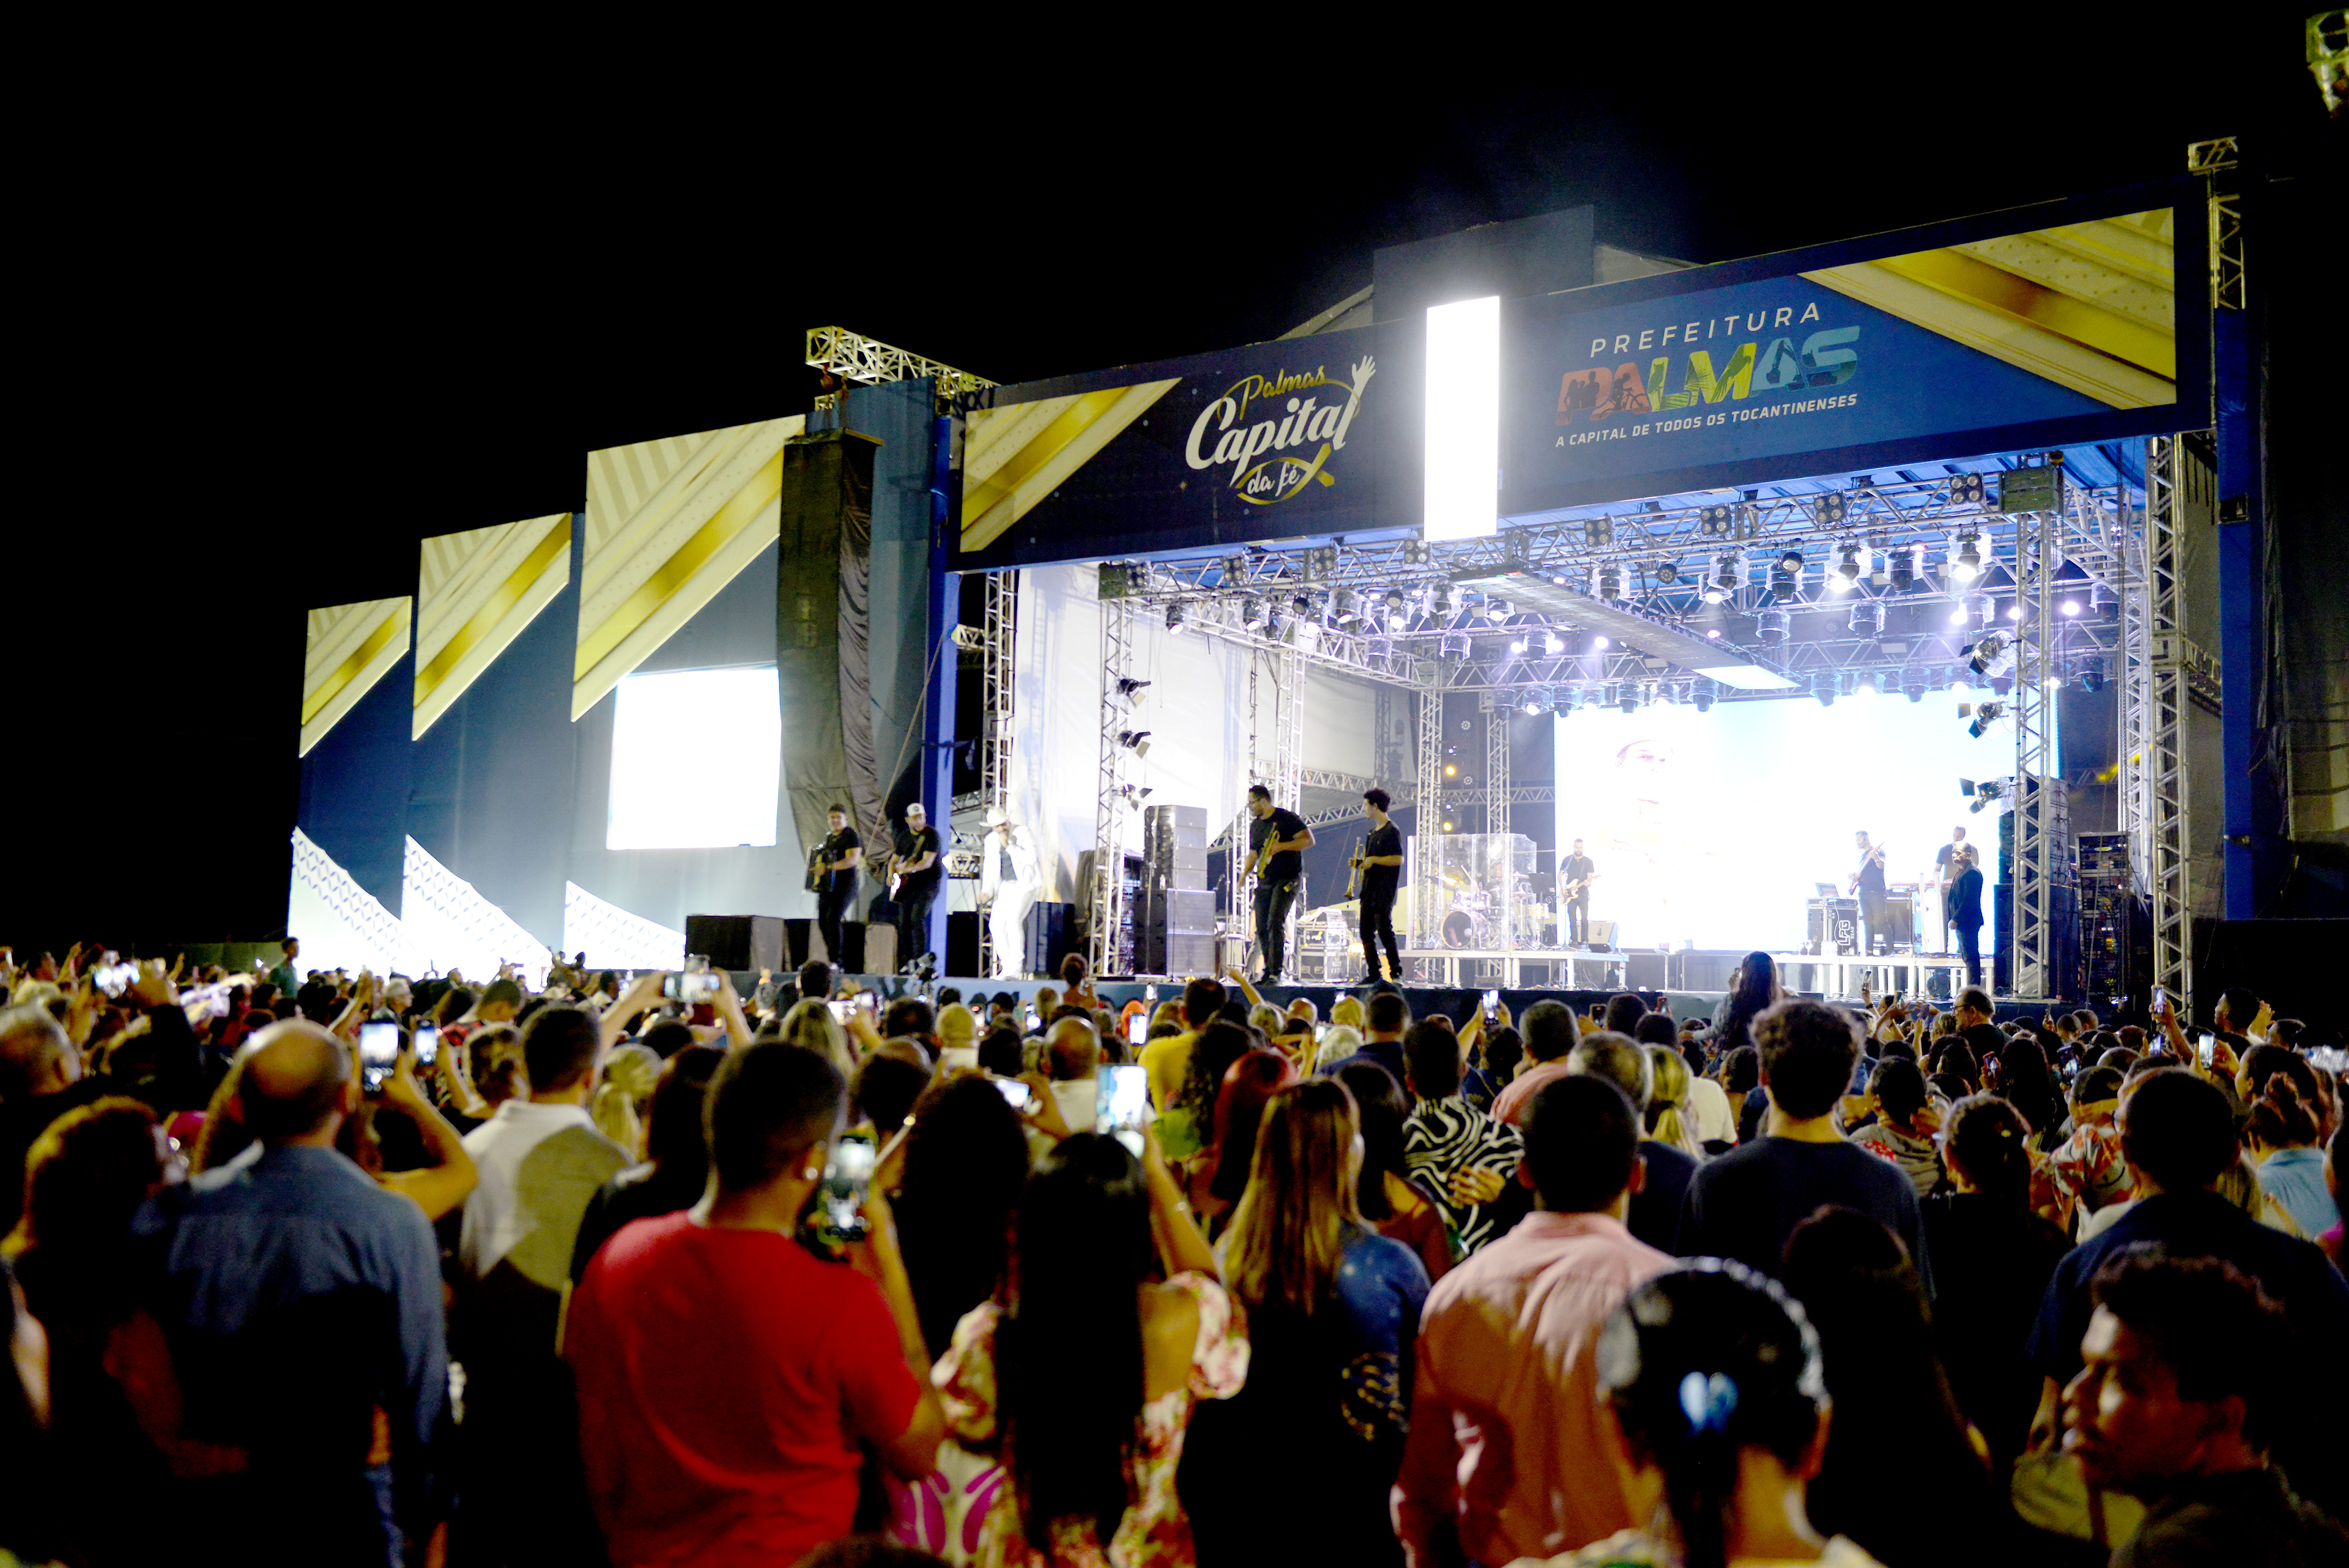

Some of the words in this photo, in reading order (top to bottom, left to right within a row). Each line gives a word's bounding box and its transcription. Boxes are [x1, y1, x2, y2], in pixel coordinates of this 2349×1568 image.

[1590, 302, 1820, 358] PREFEITURA
[1222, 365, 1326, 421] Palmas
[1555, 325, 1860, 426] PALMAS
[1186, 355, 1376, 487] Capital
[1555, 436, 1564, 447] A
[1569, 426, 1627, 446] CAPITAL
[1632, 423, 1649, 436] DE
[1655, 417, 1702, 434] TODOS
[1706, 412, 1726, 426] OS
[1731, 393, 1858, 422] TOCANTINENSES
[1247, 467, 1274, 494] da
[1275, 460, 1301, 497] fé
[1838, 920, 1850, 946] LPG
